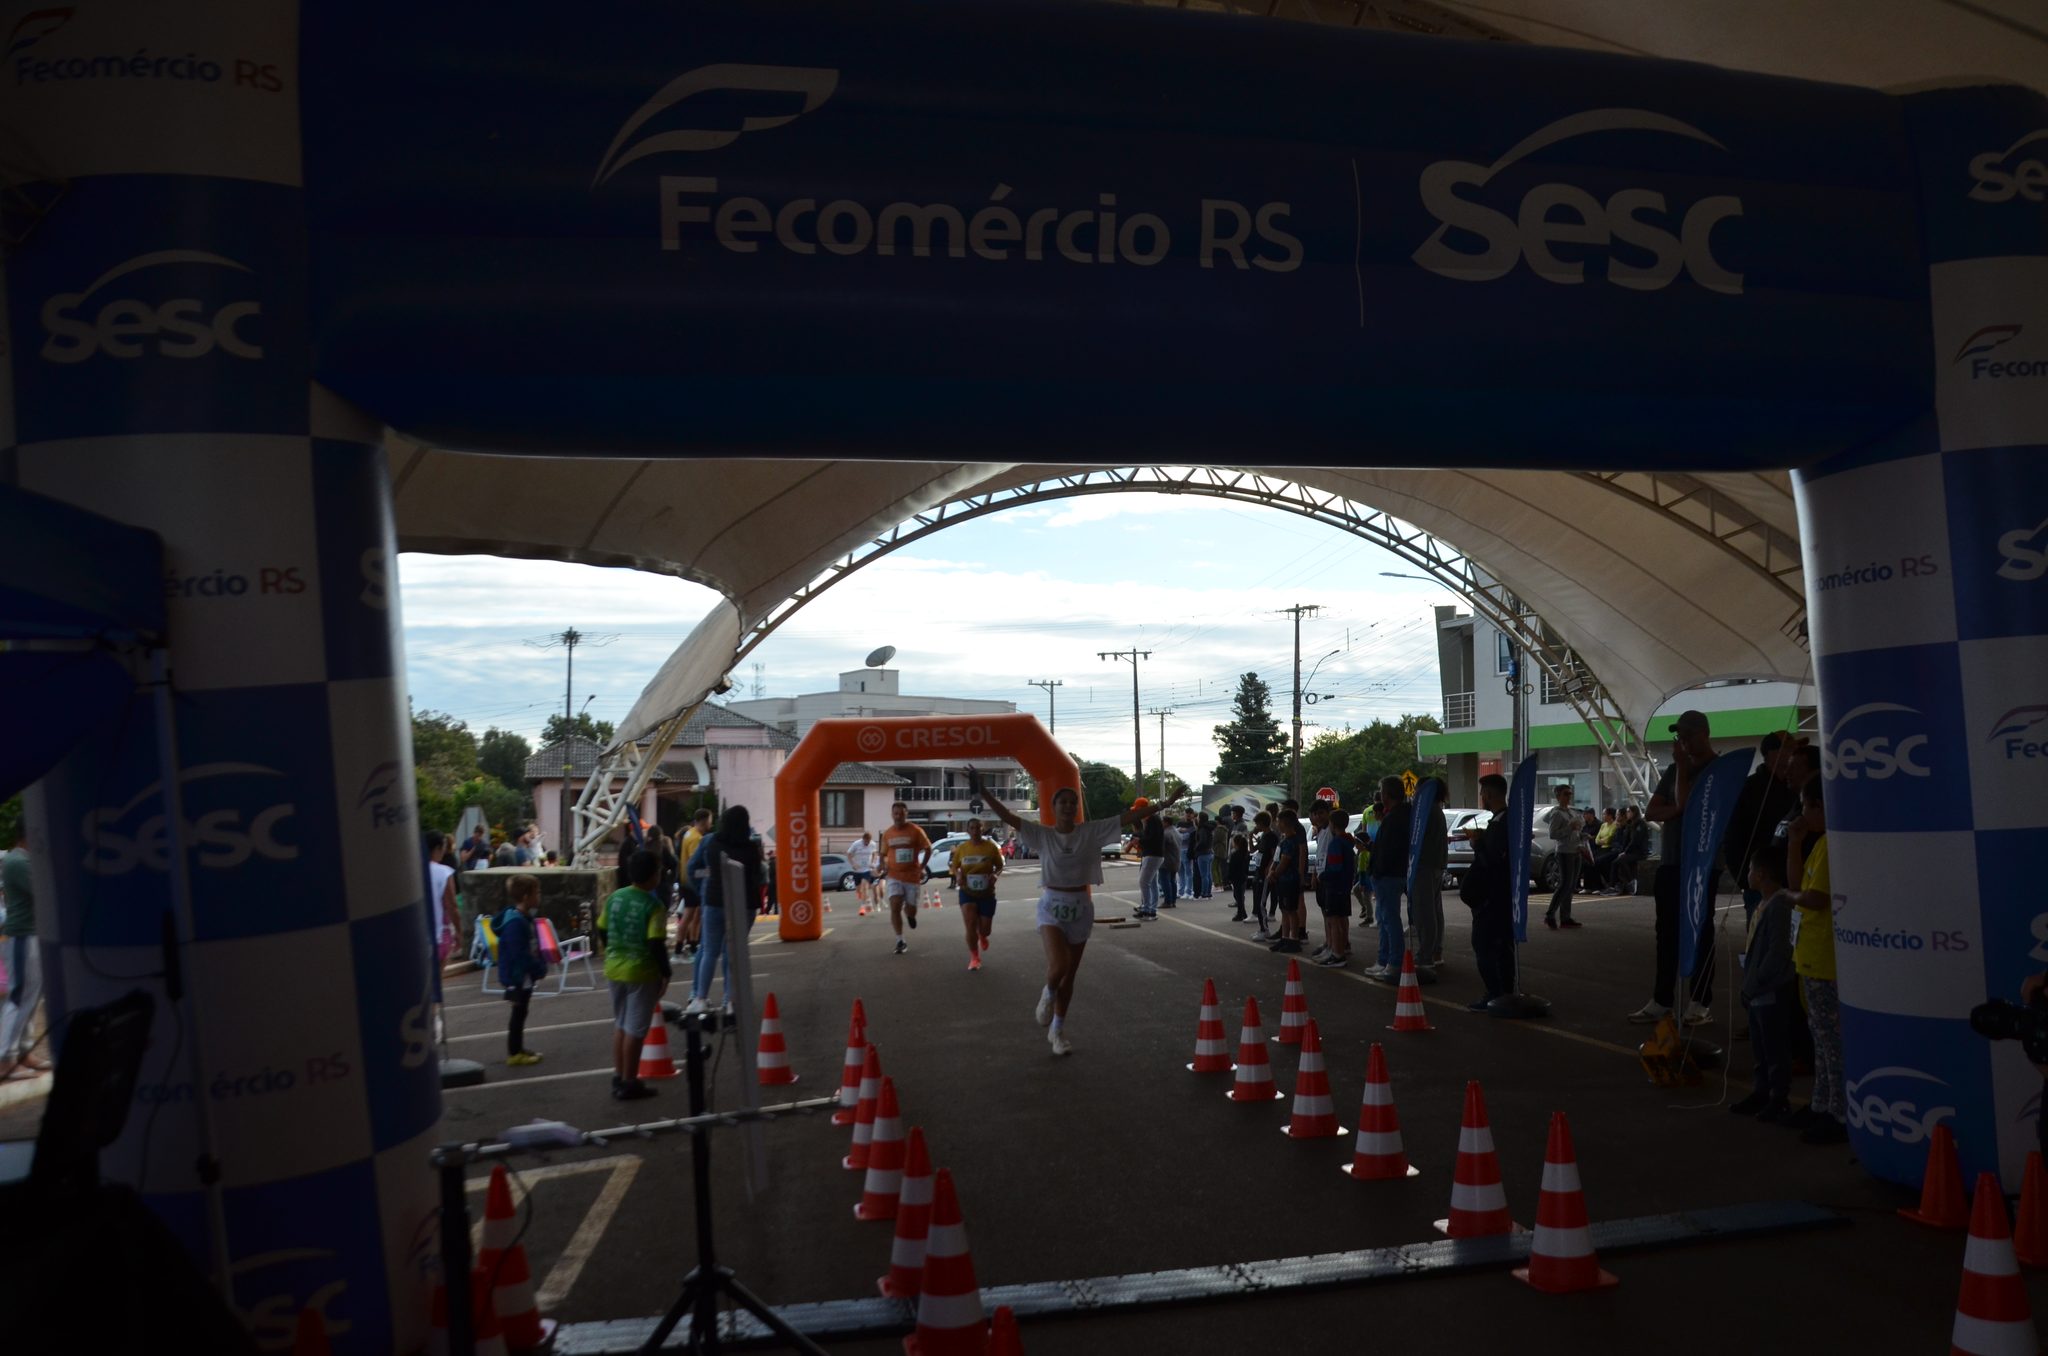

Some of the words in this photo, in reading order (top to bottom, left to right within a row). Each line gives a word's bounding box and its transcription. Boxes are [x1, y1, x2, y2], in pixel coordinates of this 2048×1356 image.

[16, 49, 222, 85] Fecomércio
[234, 58, 283, 92] RS
[658, 175, 1171, 267] Fecomércio
[1199, 198, 1305, 273] RS
[1411, 159, 1745, 295] Sesc
[39, 292, 265, 365] Sesc
[260, 567, 305, 595] RS
[1900, 554, 1938, 579] RS
[895, 725, 1001, 750] CRESOL
[790, 803, 808, 894] CRESOL
[1052, 905, 1077, 921] 131
[1931, 930, 1969, 951] RS
[305, 1052, 350, 1086] RS
